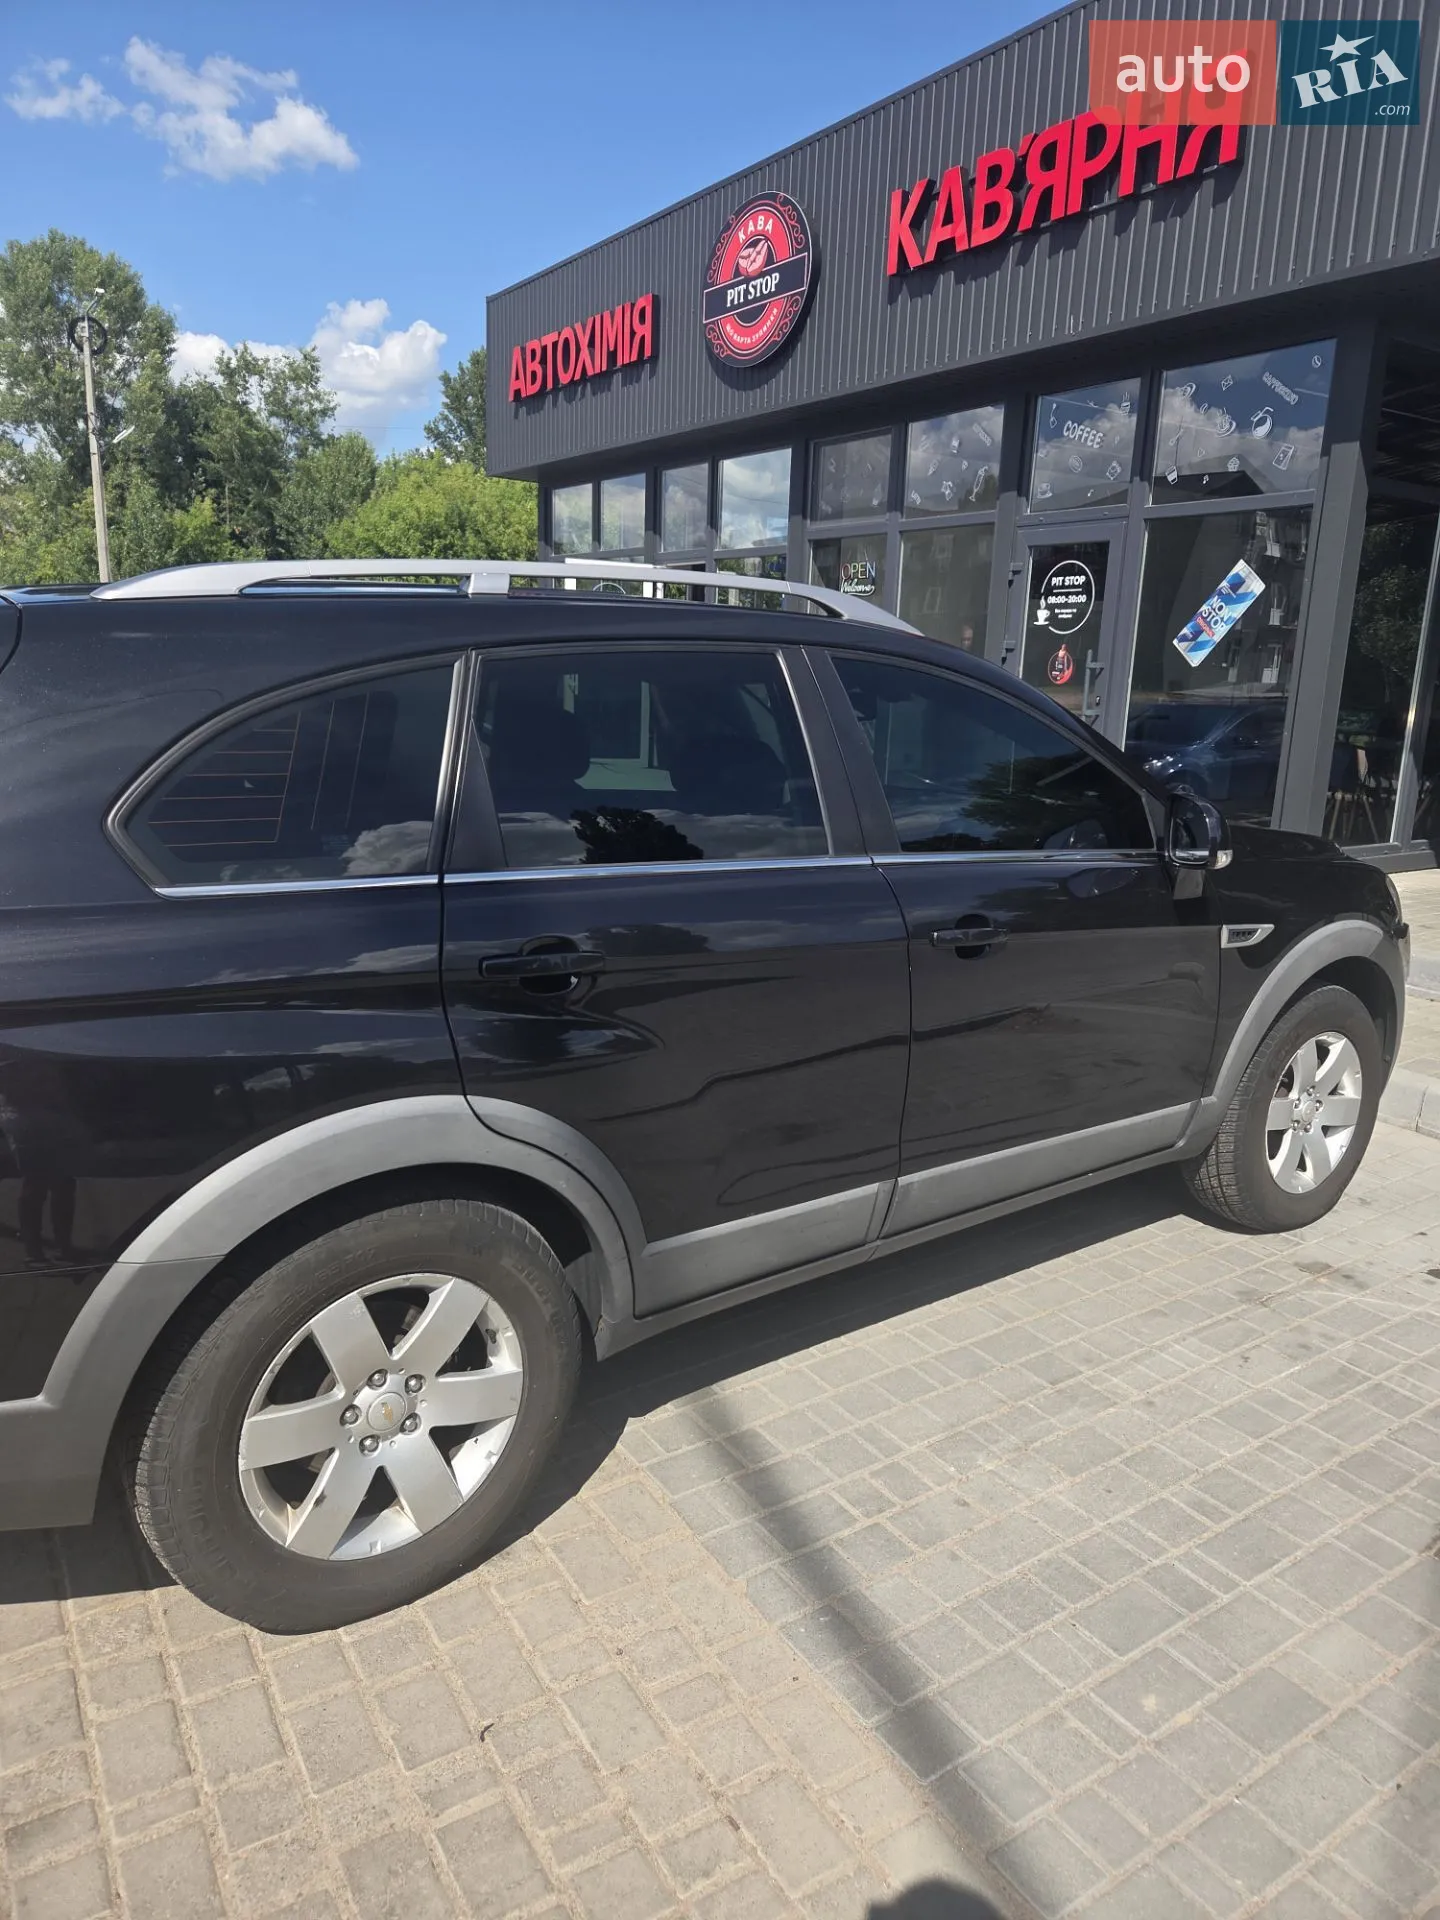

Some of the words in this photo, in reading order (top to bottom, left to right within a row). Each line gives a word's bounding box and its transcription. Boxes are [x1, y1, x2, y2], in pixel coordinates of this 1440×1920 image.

[738, 215, 773, 243] КАВА
[727, 286, 746, 307] PIT
[748, 273, 780, 300] STOP
[509, 293, 653, 402] АВТОХІМІЯ
[1063, 420, 1104, 449] COFFEE
[842, 561, 876, 579] OPEN
[1051, 577, 1064, 586] PIT
[1065, 575, 1086, 586] STOP
[1201, 606, 1226, 632] STOP
[1210, 595, 1232, 622] NON
